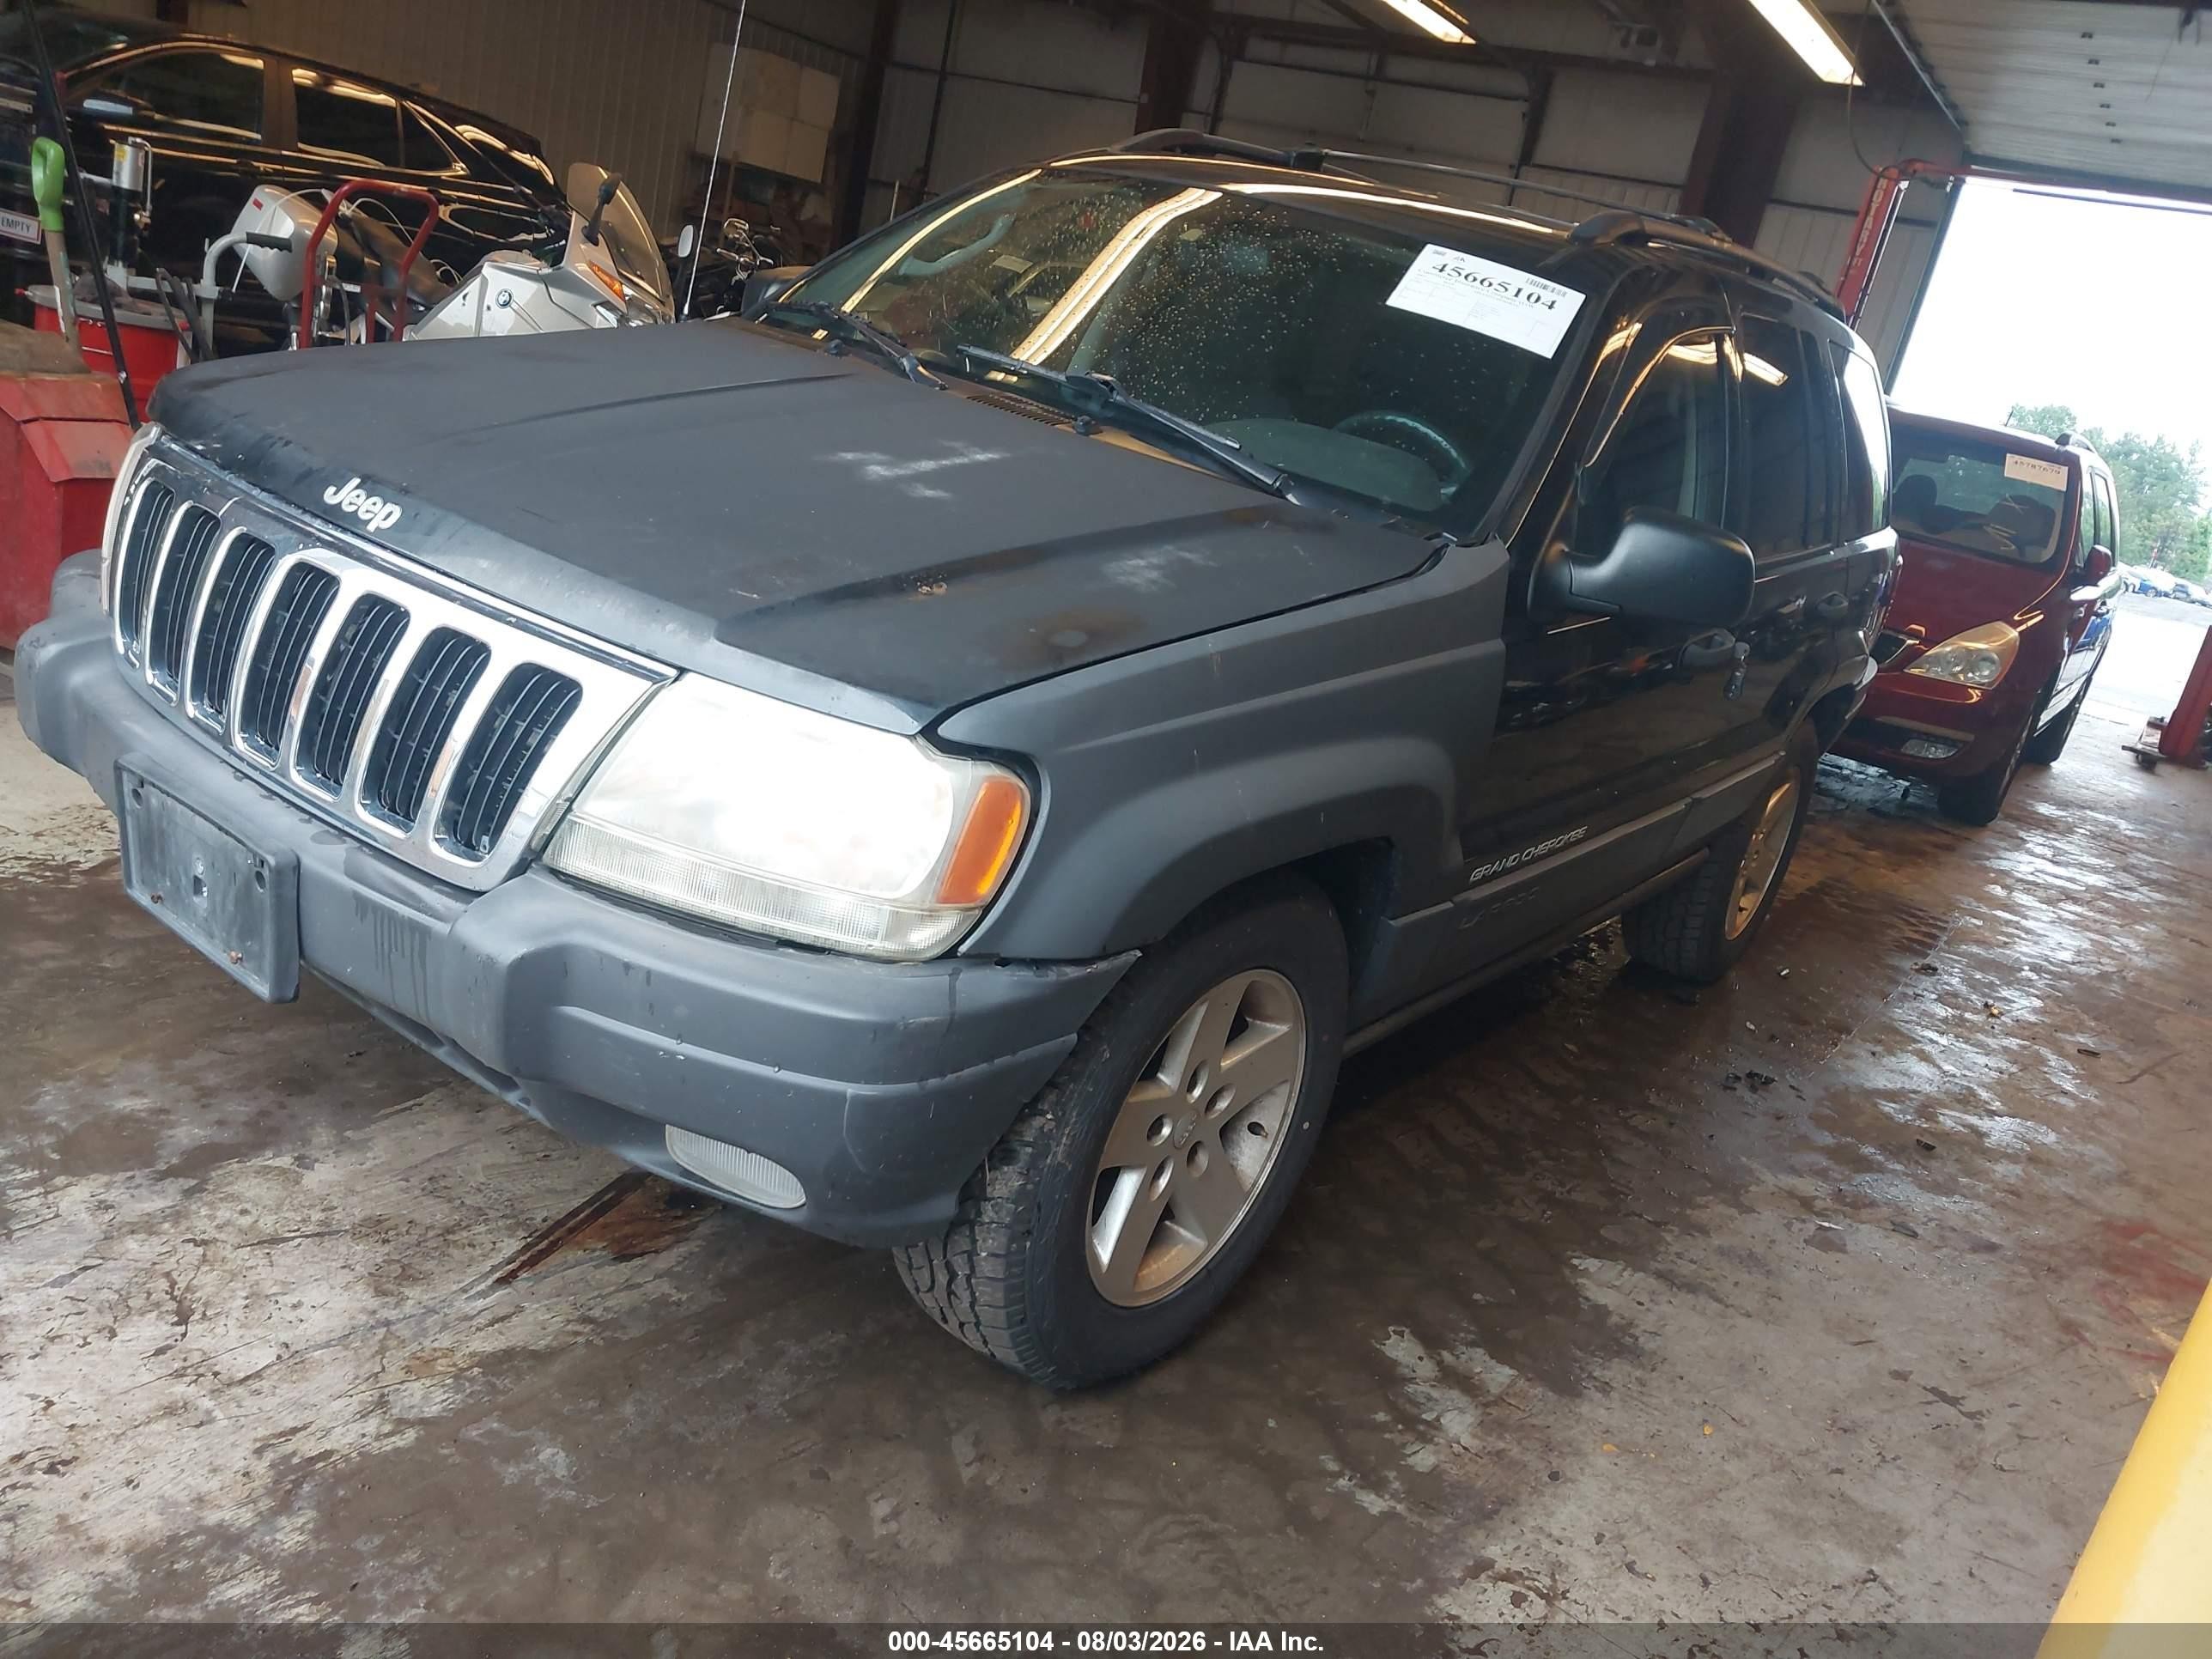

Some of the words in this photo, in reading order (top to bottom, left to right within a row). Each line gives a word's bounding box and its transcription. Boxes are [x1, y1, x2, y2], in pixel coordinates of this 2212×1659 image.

[1, 216, 32, 234] EMPTY
[1431, 263, 1558, 310] 45665104
[323, 477, 403, 533] Jeep
[1469, 853, 1520, 882] GRAND
[1522, 826, 1588, 860] CHEROKEE
